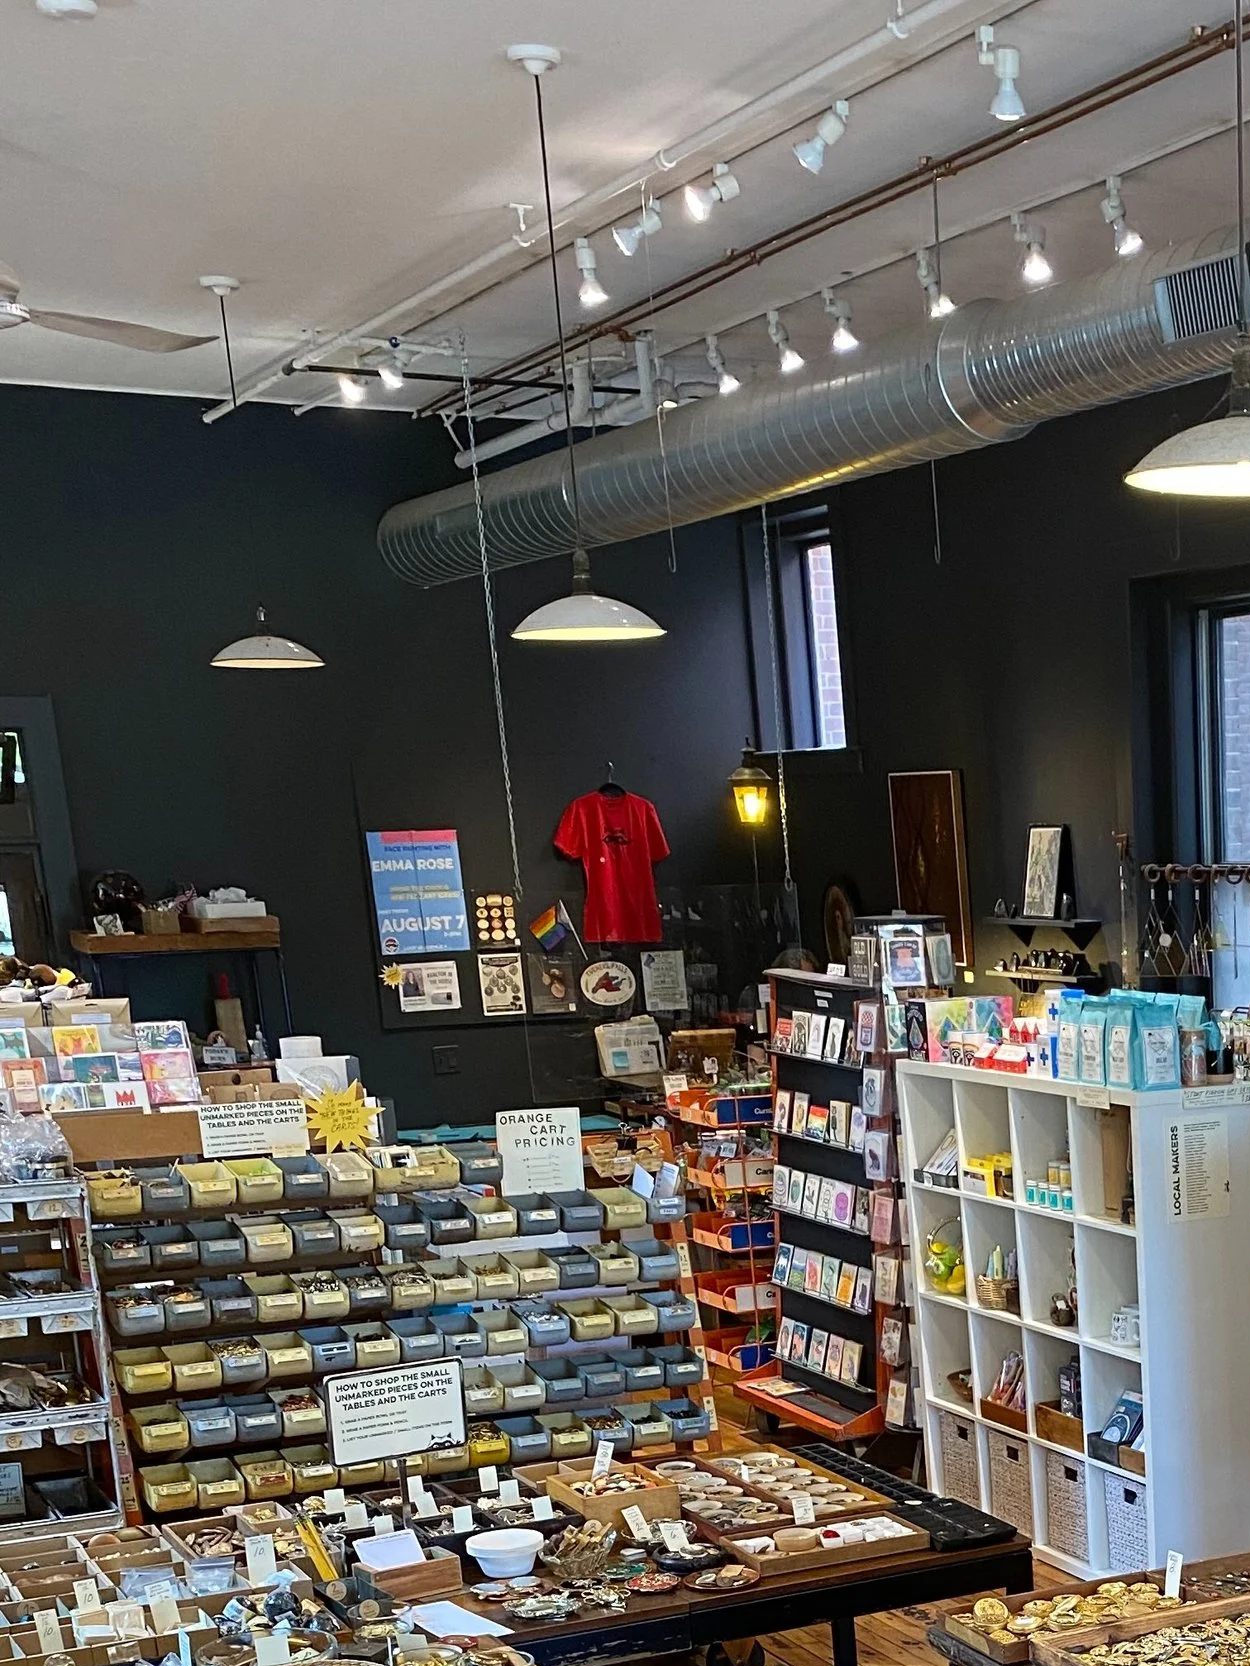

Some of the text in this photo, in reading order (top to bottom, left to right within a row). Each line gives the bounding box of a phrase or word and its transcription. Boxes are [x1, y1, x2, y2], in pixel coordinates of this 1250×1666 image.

[372, 858, 454, 872] EMMA ROSE
[382, 915, 465, 934] AUGUST 7
[200, 1112, 245, 1121] UNMARKED
[500, 1114, 552, 1126] ORANGE
[530, 1124, 566, 1135] CART
[514, 1137, 576, 1148] PRICING
[1170, 1125, 1182, 1216] LOCAL MAKERS
[336, 1383, 358, 1393] HOW
[374, 1376, 399, 1386] SHOP
[401, 1373, 418, 1381] THE
[420, 1369, 450, 1379] SMALL
[335, 1388, 385, 1402] UNMARKED
[387, 1383, 418, 1393] PIECES
[436, 1378, 452, 1386] THE
[342, 1388, 446, 1411] TABLES AND THE CARTS
